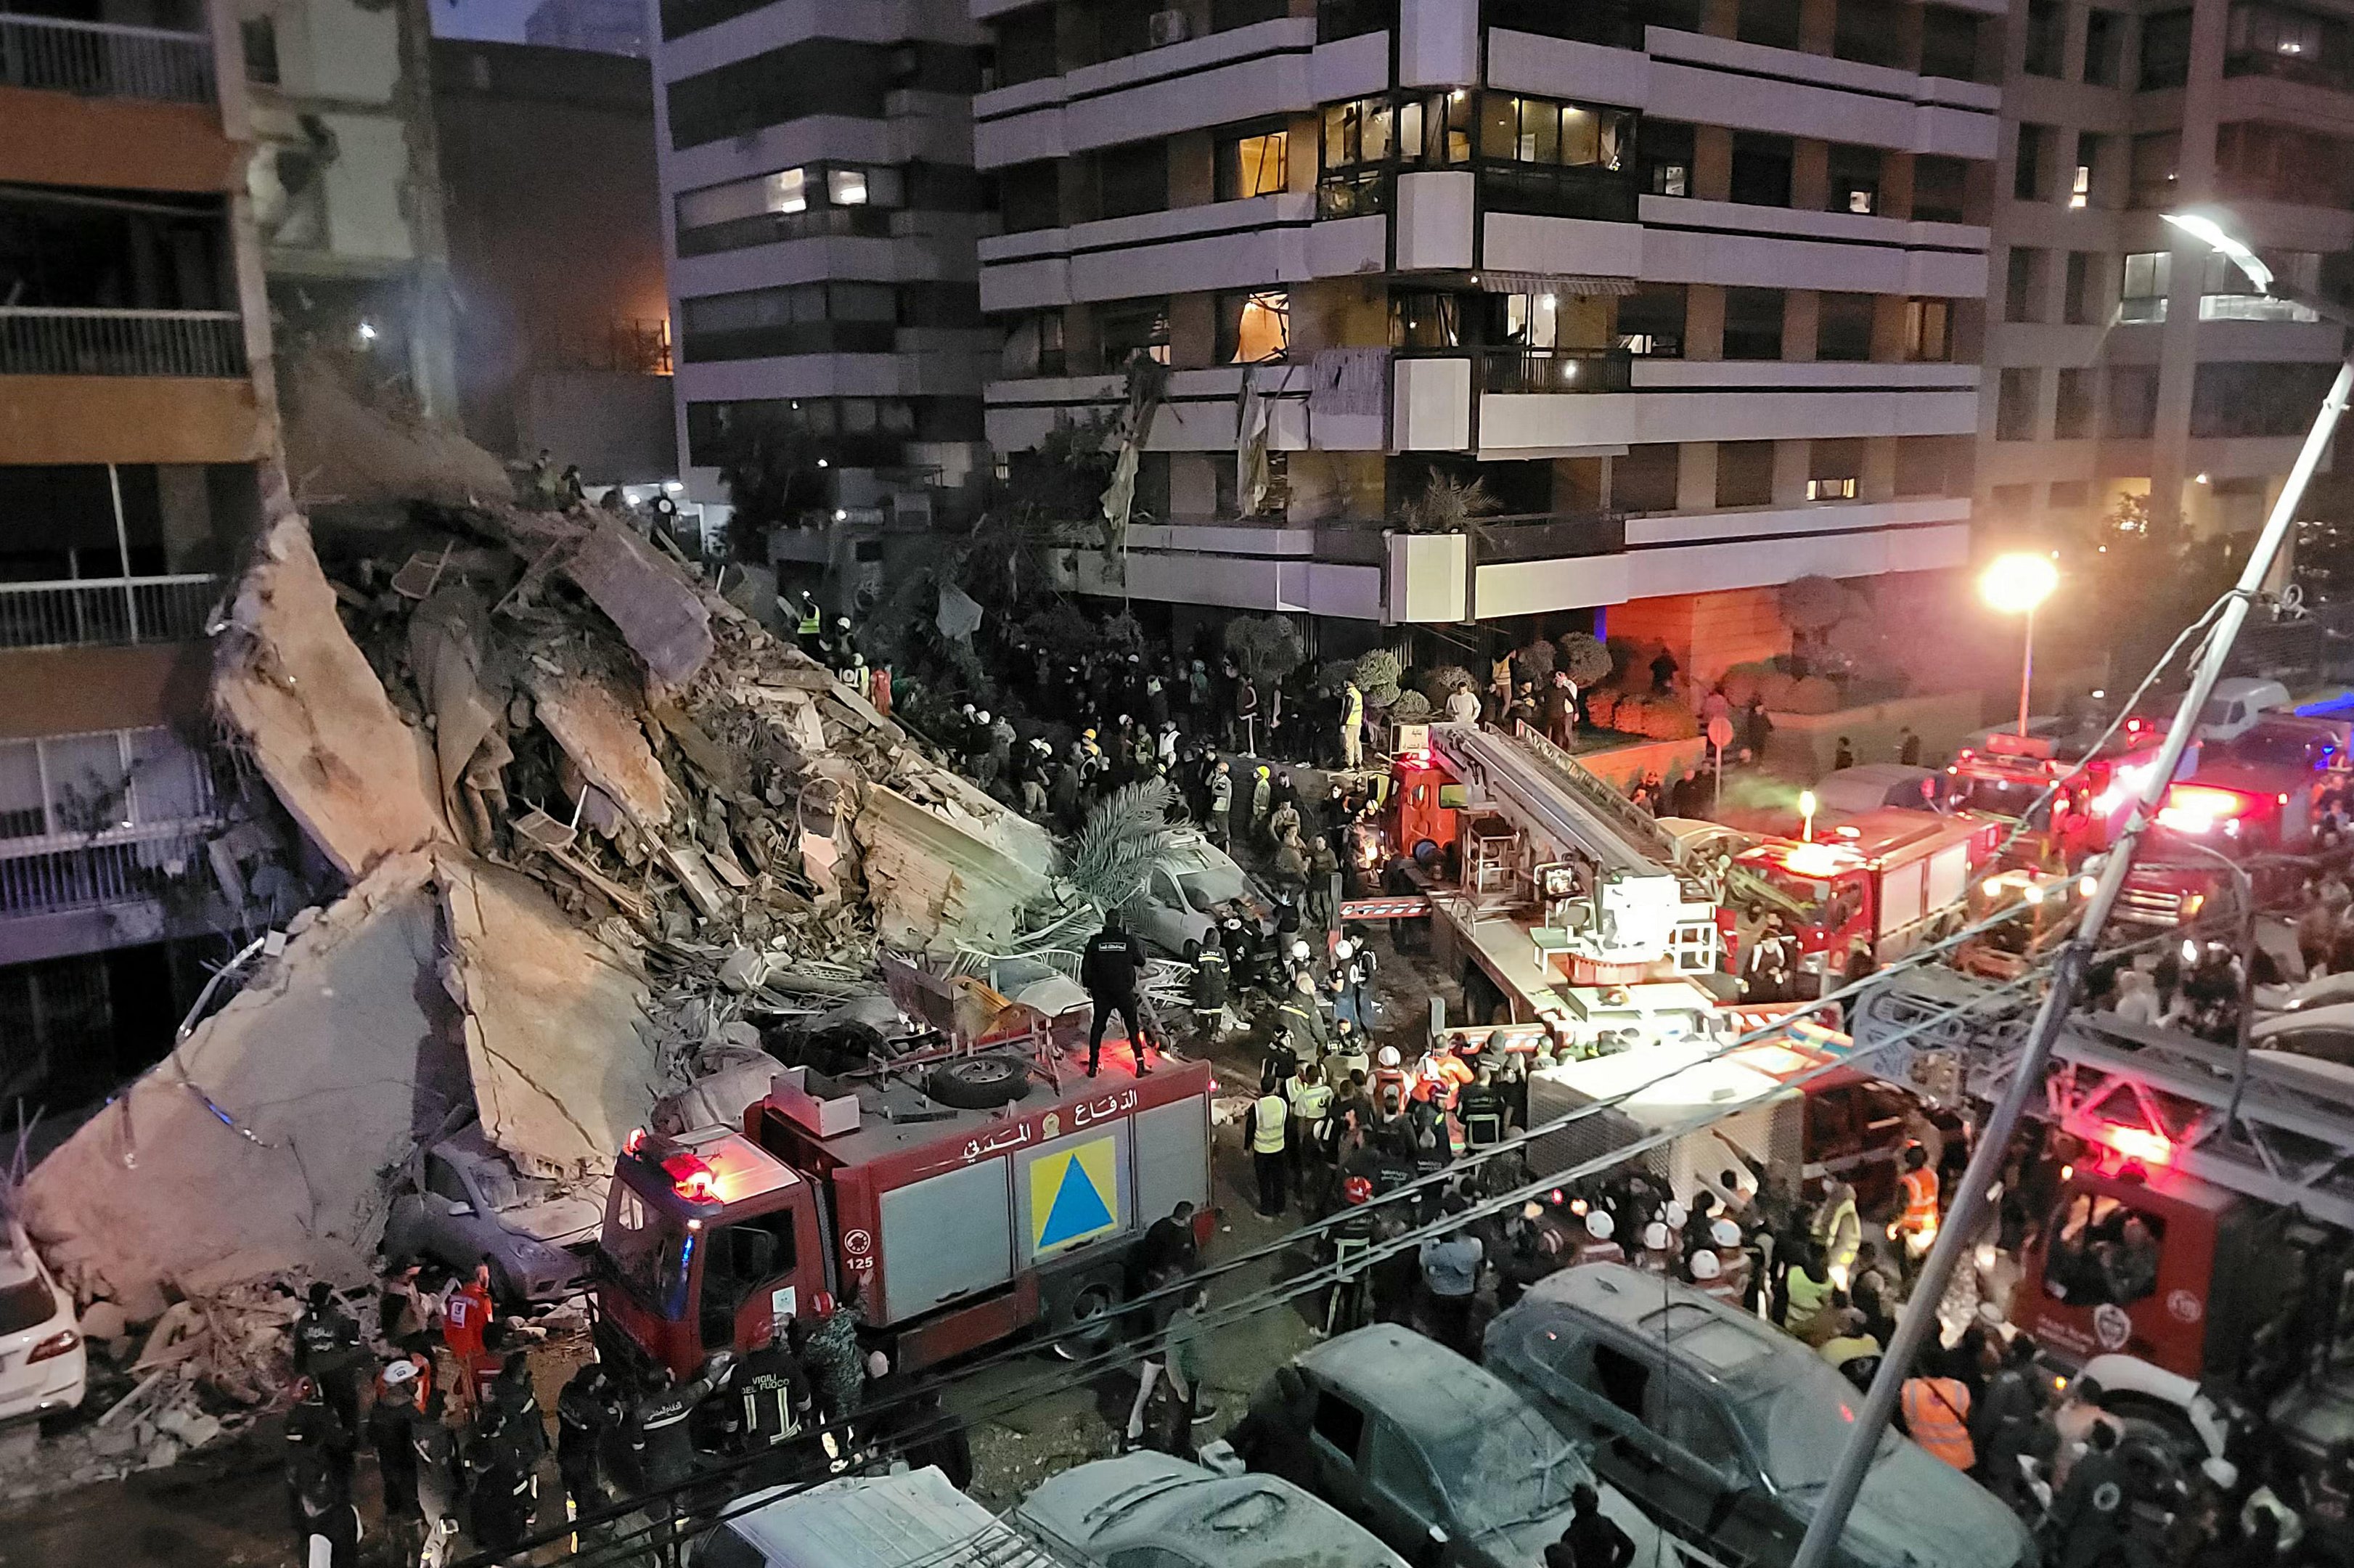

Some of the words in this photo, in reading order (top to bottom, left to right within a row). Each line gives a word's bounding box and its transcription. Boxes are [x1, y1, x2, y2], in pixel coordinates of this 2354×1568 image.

[846, 1256, 873, 1270] 125
[752, 1373, 776, 1384] VIGILI
[741, 1386, 757, 1395] DEL
[760, 1378, 790, 1391] FUOCO
